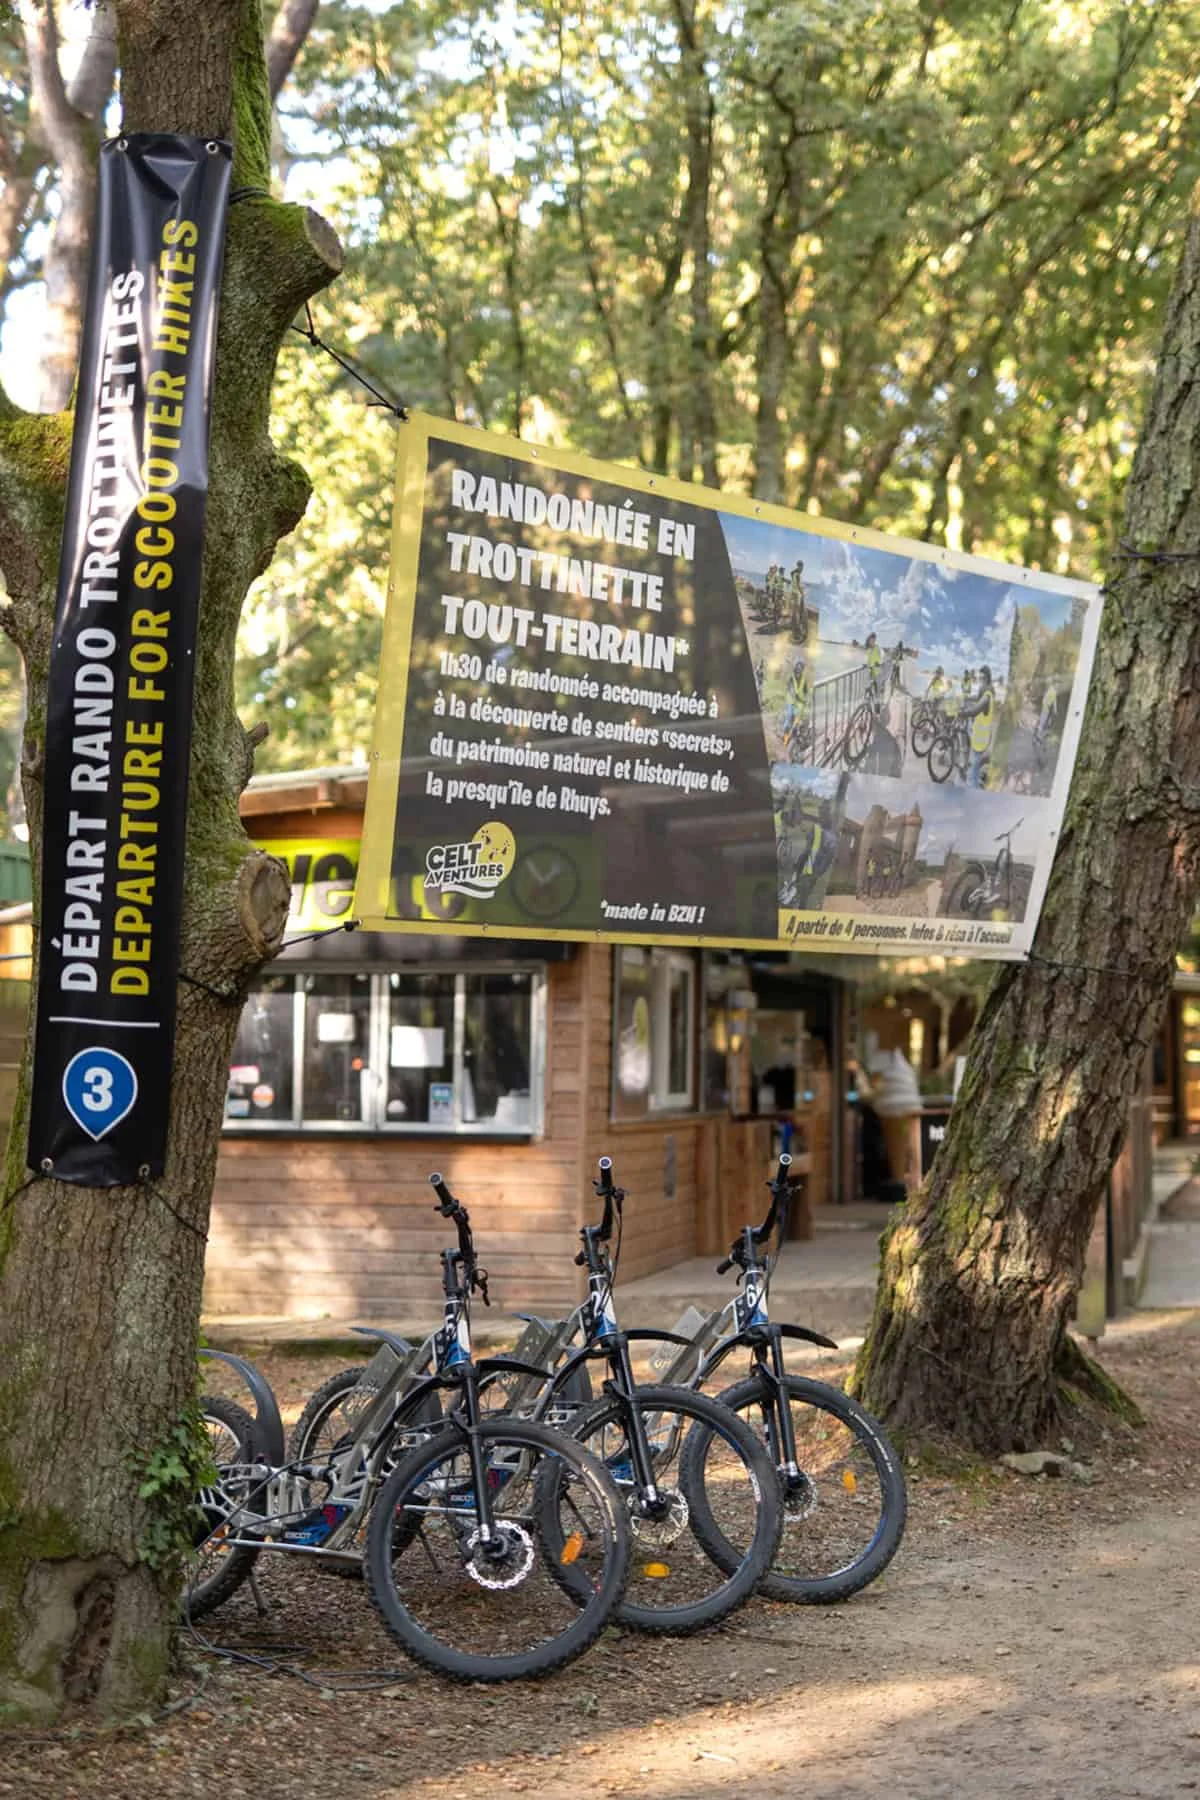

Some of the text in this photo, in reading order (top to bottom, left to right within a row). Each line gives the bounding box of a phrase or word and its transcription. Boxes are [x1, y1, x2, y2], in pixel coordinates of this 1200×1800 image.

[451, 468, 696, 561] RANDONNÉE EN
[446, 532, 664, 612] TROTTINETTE
[110, 218, 199, 996] DEPARTURE FOR SCOOTER HIKES
[51, 269, 145, 993] DÉPART RANDO TROTTINETTES
[439, 651, 719, 720] 1h30 de randonnée accompagnée à
[433, 689, 735, 761] à la découverte de sentiers «secrets»,
[430, 731, 730, 795] du patrimoine naturel et historique de
[425, 771, 612, 821] la presqu'île de Rhuys.
[424, 863, 505, 888] AVENTURES
[426, 842, 482, 872] CELT
[650, 902, 666, 921] in
[667, 904, 697, 923] BZH
[786, 915, 797, 934] A
[791, 916, 829, 945] partir
[829, 919, 844, 936] de
[844, 919, 854, 936] 4
[909, 922, 936, 941] Infos
[81, 1065, 114, 1112] 3
